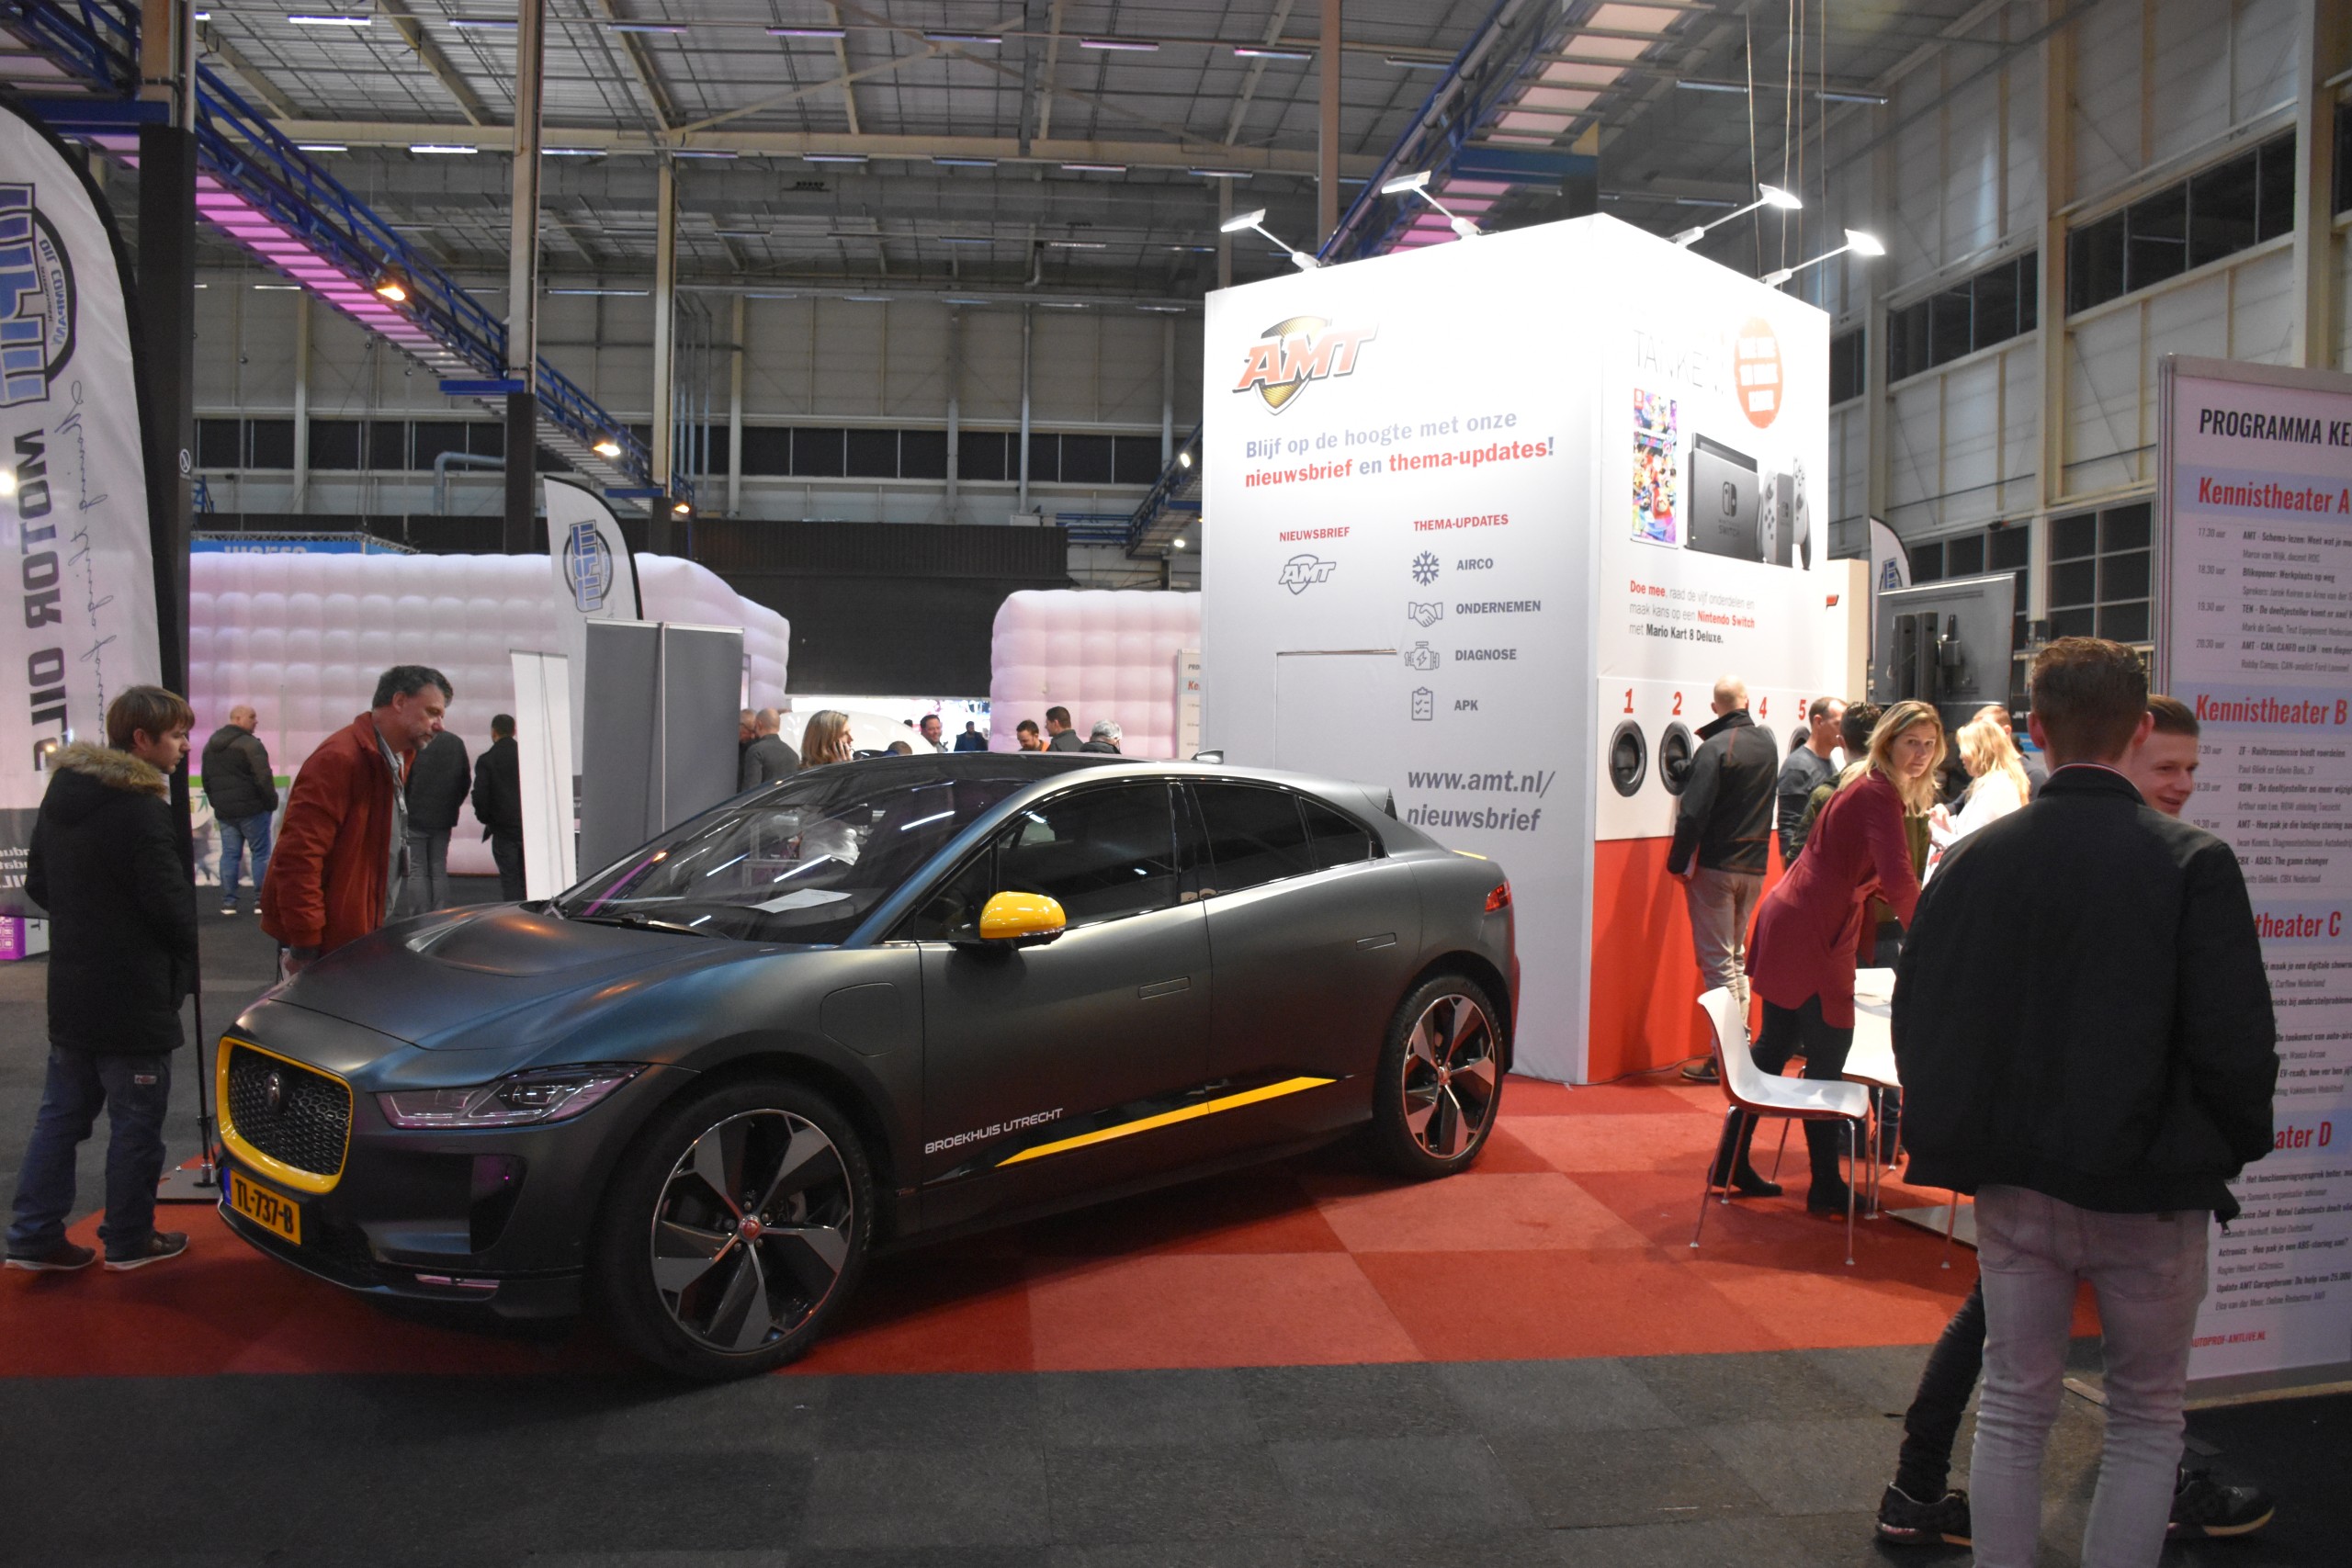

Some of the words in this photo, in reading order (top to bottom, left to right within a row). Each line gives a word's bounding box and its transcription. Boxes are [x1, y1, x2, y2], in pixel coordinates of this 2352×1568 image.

[1232, 323, 1378, 393] AMT
[1247, 438, 1281, 459] Blijf
[1288, 438, 1309, 456] op
[1316, 433, 1338, 450] de
[1345, 424, 1411, 446] hoogte
[1420, 416, 1458, 437] met
[1466, 413, 1517, 432] onze
[2199, 409, 2322, 445] PROGRAMMA
[1245, 459, 1352, 487] nieuwsbrief
[1359, 460, 1382, 475] en
[1389, 437, 1555, 471] thema-updates!
[2199, 477, 2333, 513] Kennistheater
[2337, 489, 2349, 514] A
[1280, 527, 1350, 542] NIEUWSBRIEF
[1414, 514, 1509, 531] THEMA-UPDATES
[2243, 531, 2256, 540] AMT
[1279, 562, 1336, 584] AMT
[1457, 558, 1493, 570] AIRCO
[1631, 581, 1645, 593] Doe
[1670, 589, 1685, 600] raad
[1687, 590, 1696, 602] de
[1709, 593, 1744, 608] onderdelen
[1456, 601, 1541, 615] ONDERNEMEN
[1629, 604, 1650, 615] maak
[1653, 604, 1669, 618] kans
[1672, 608, 1680, 620] op
[1683, 611, 1695, 621] een
[1698, 611, 1729, 625] Nintendo
[1732, 615, 1755, 628] Switch
[1629, 624, 1644, 635] met
[1646, 624, 1668, 637] Mario
[1671, 626, 1687, 639] Kart
[1690, 629, 1693, 640] 8
[1696, 630, 1724, 643] Deluxe.
[1455, 649, 1517, 661] DIAGNOSE
[1454, 700, 1478, 711] APK
[1624, 688, 1634, 714] 1
[1672, 692, 1682, 716] 2
[1759, 697, 1767, 718] 4
[1799, 700, 1806, 720] 5
[2196, 694, 2329, 725] Kennistheater
[2335, 699, 2347, 725] B
[1408, 771, 1555, 798] www.amt.nl/
[1407, 804, 1542, 831] nieuwsbrief
[2237, 820, 2251, 829] AMT
[2329, 911, 2341, 937] C
[925, 1124, 1001, 1154] BROEKHUIS
[1003, 1108, 1063, 1133] UTRECHT
[2318, 1122, 2331, 1146] D
[235, 1179, 294, 1234] TL-737-B
